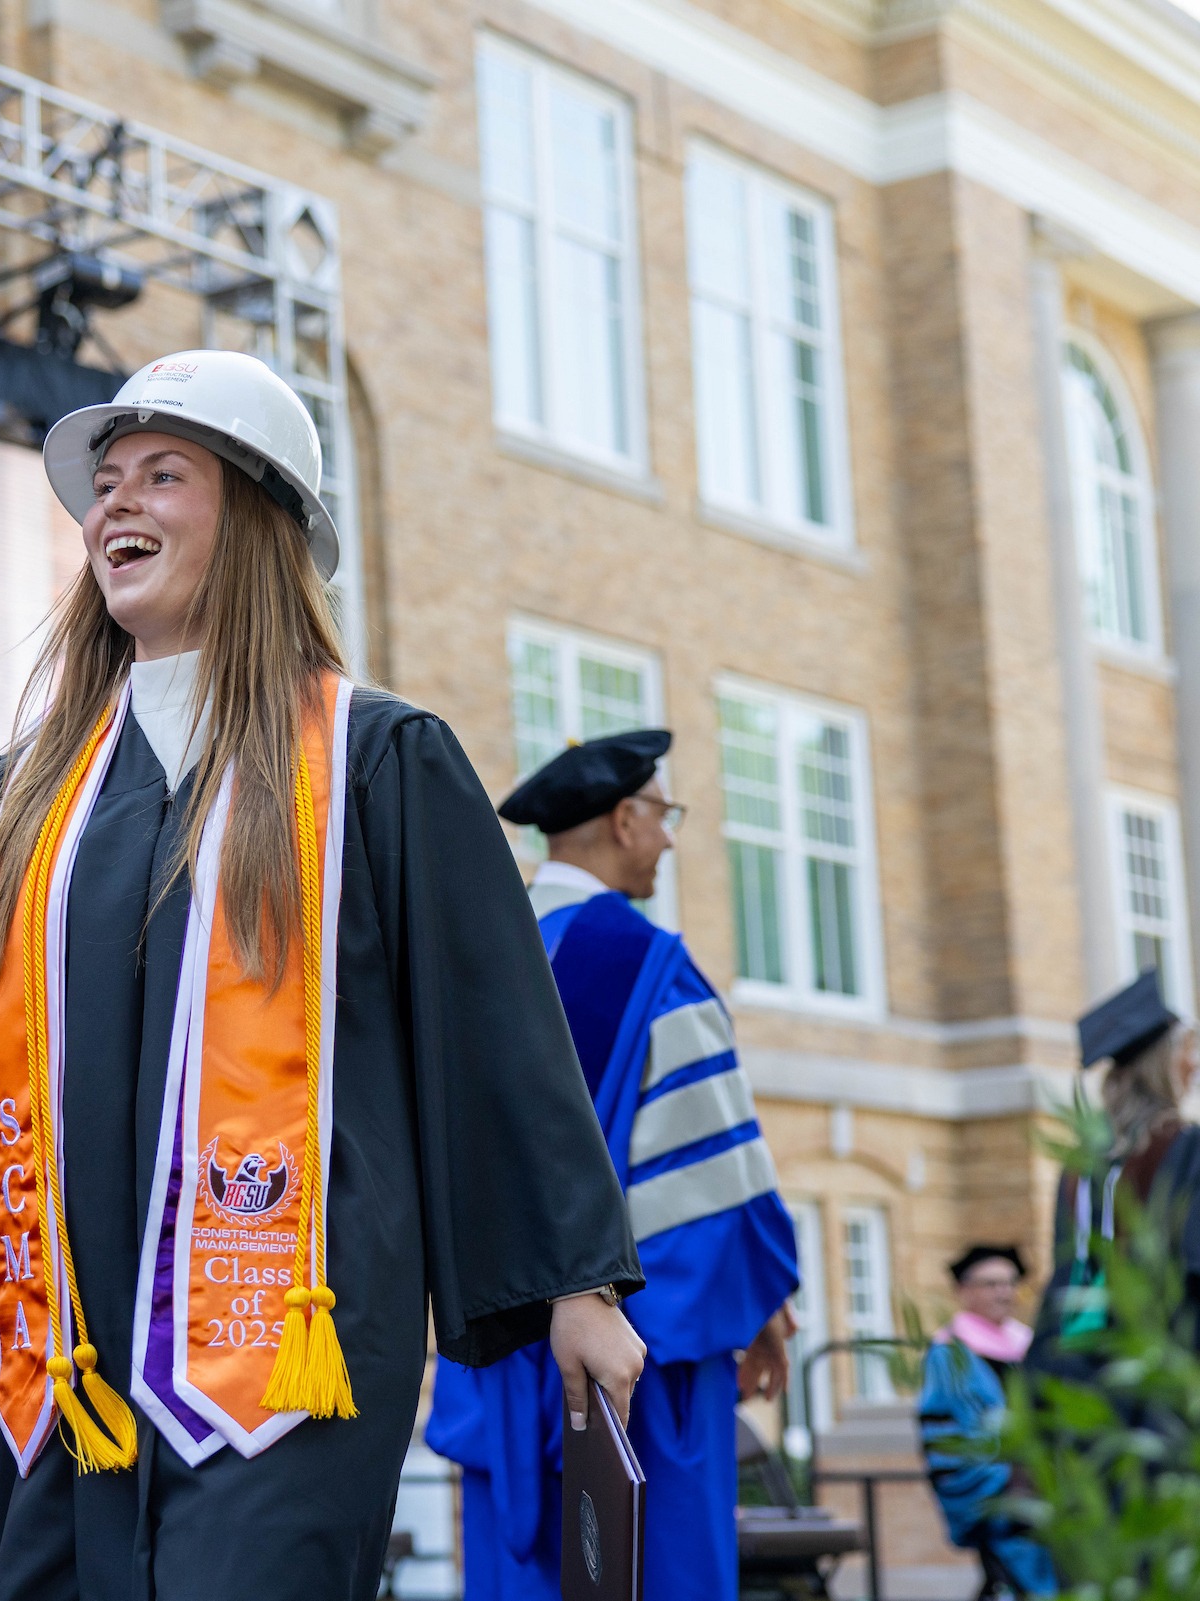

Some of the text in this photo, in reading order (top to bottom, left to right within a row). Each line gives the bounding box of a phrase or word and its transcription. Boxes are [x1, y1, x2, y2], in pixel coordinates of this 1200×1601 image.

[151, 399, 184, 407] JOHNSON
[222, 1182, 272, 1210] BGSU
[191, 1227, 299, 1242] CONSTRUCTION
[195, 1239, 297, 1253] MANAGEMENT
[204, 1256, 291, 1285] Class
[231, 1289, 266, 1316] of
[207, 1319, 284, 1348] 2025
